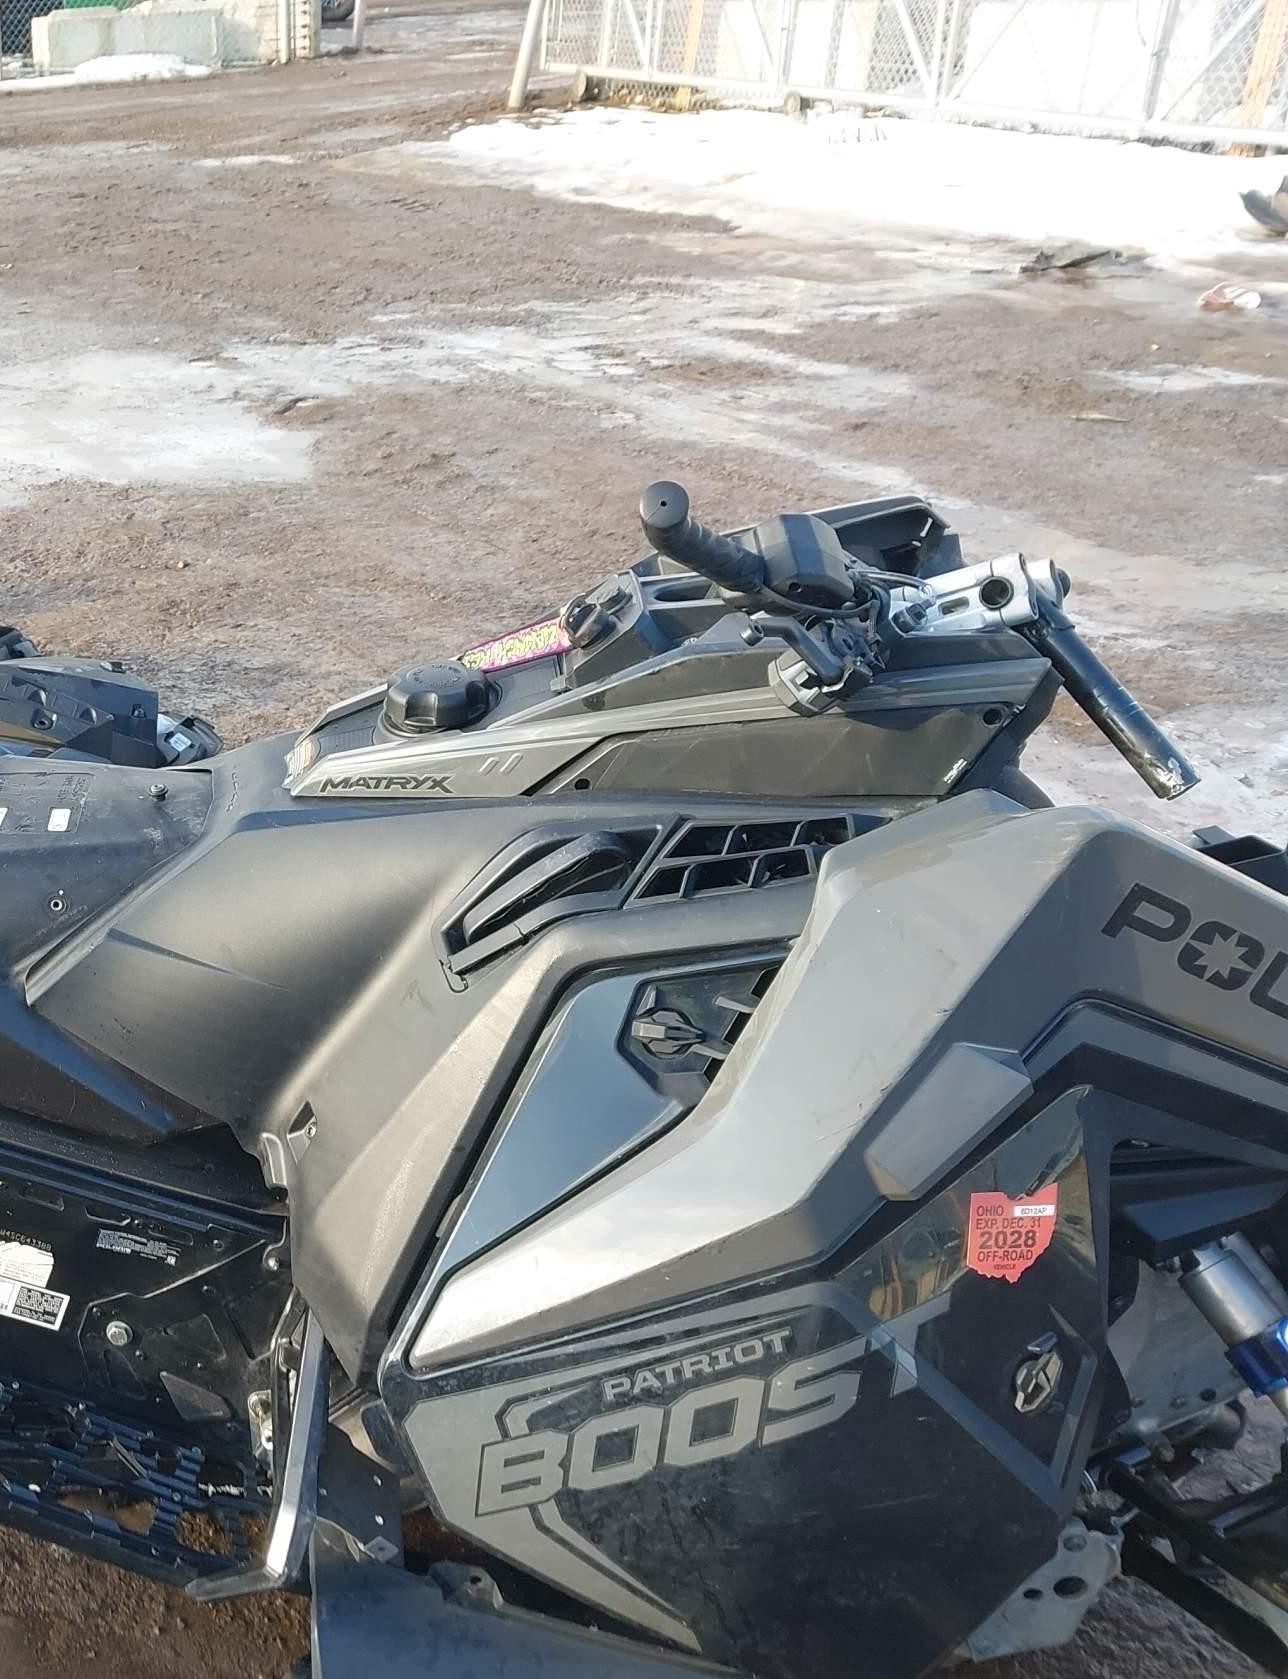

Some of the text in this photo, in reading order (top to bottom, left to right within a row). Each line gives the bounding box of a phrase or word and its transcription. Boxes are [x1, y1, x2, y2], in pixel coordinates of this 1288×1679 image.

[319, 776, 454, 794] MATRYX
[976, 1205, 1004, 1217] OHIO
[976, 1217, 1041, 1230] EXP. DEC. 31
[979, 1230, 1036, 1249] 2028
[977, 1249, 1033, 1262] OFF-ROAD
[602, 1327, 793, 1401] PATRIOT
